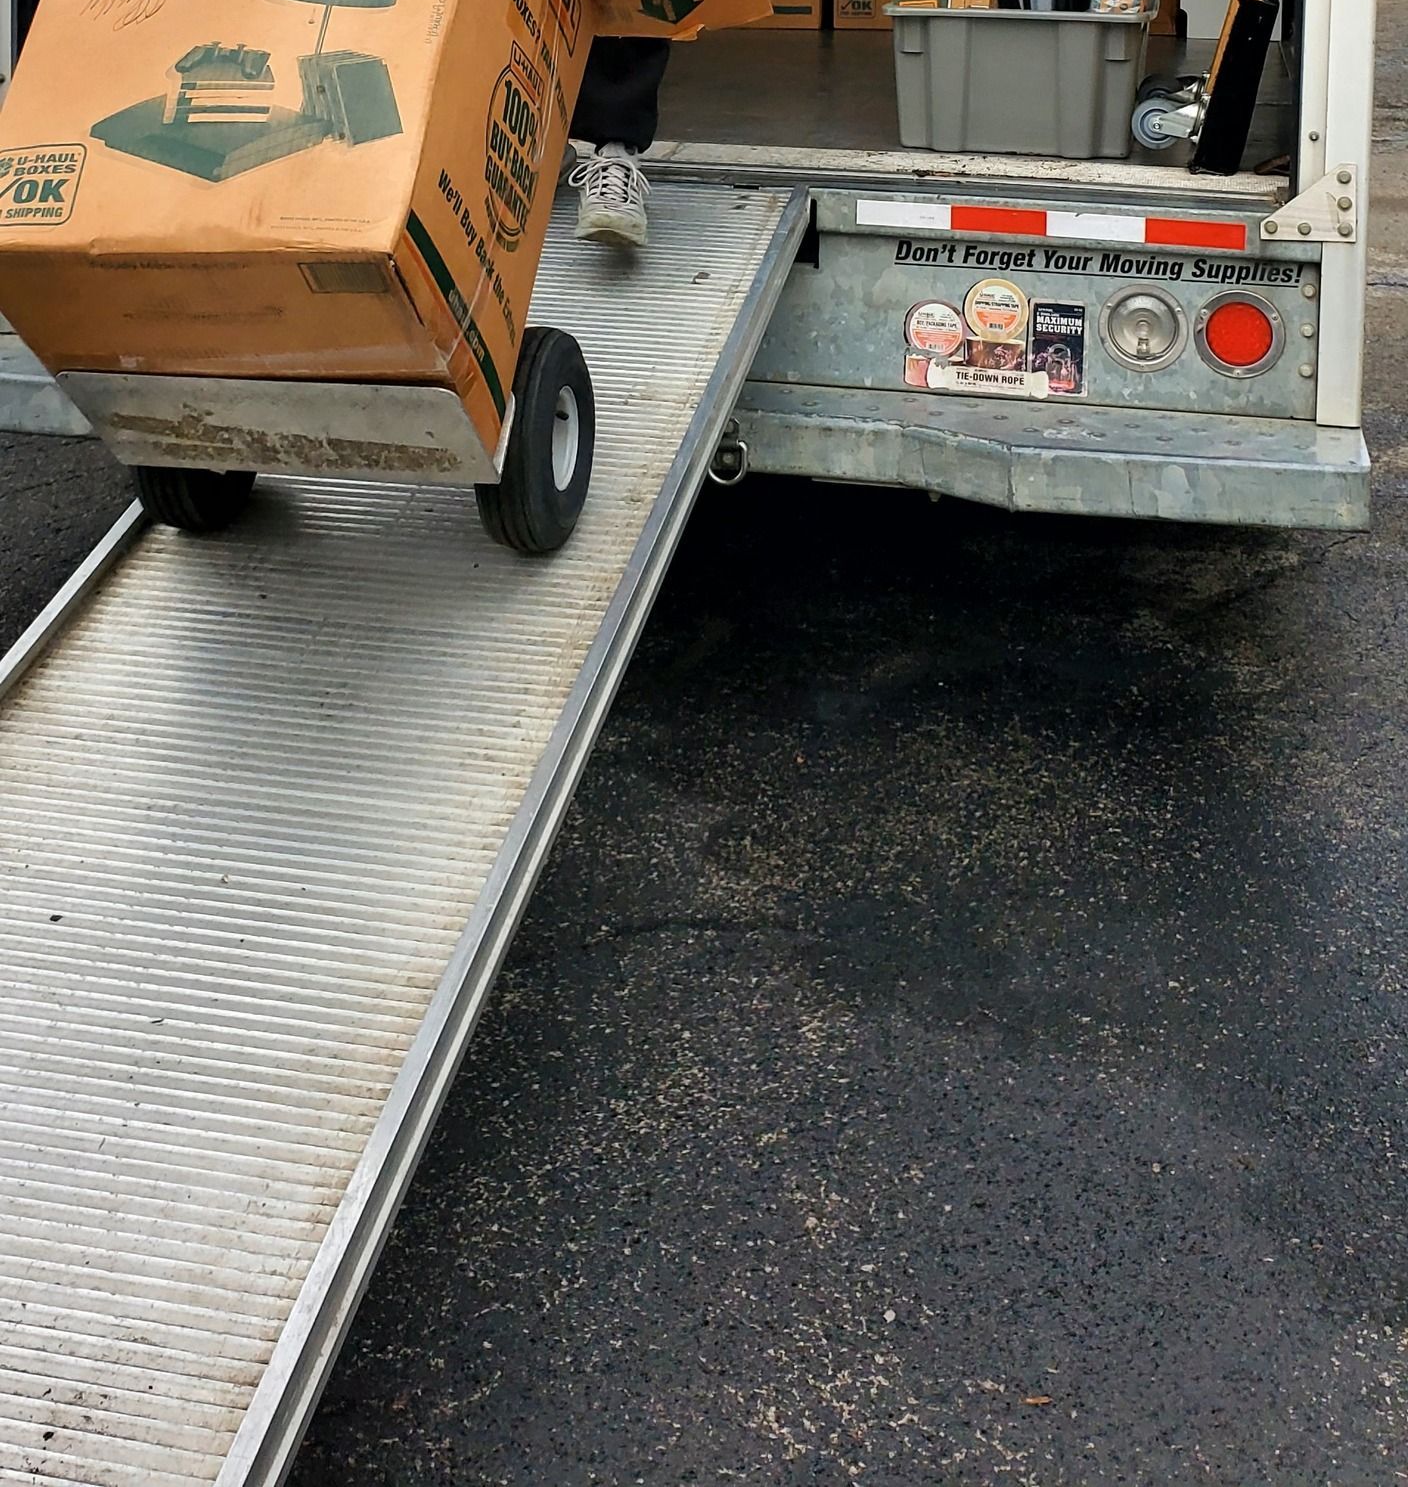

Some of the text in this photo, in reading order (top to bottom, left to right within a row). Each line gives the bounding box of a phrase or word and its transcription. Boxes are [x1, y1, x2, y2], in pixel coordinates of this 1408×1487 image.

[851, 0, 873, 11] OK
[17, 153, 78, 166] U-HAUL
[13, 164, 77, 177] BOXES
[13, 179, 71, 204] OK
[5, 207, 63, 218] SHIPPING
[438, 167, 463, 216] We'll
[460, 207, 477, 247] Buy
[475, 236, 495, 280] Back
[493, 272, 505, 305] the
[895, 240, 1302, 286] Don't Forget Your Moving Supplies!
[1036, 315, 1083, 327] MAXIMUM
[1036, 324, 1083, 335] SECURITY
[956, 371, 999, 384] TIE-DOWN
[1002, 375, 1025, 386] ROPE
